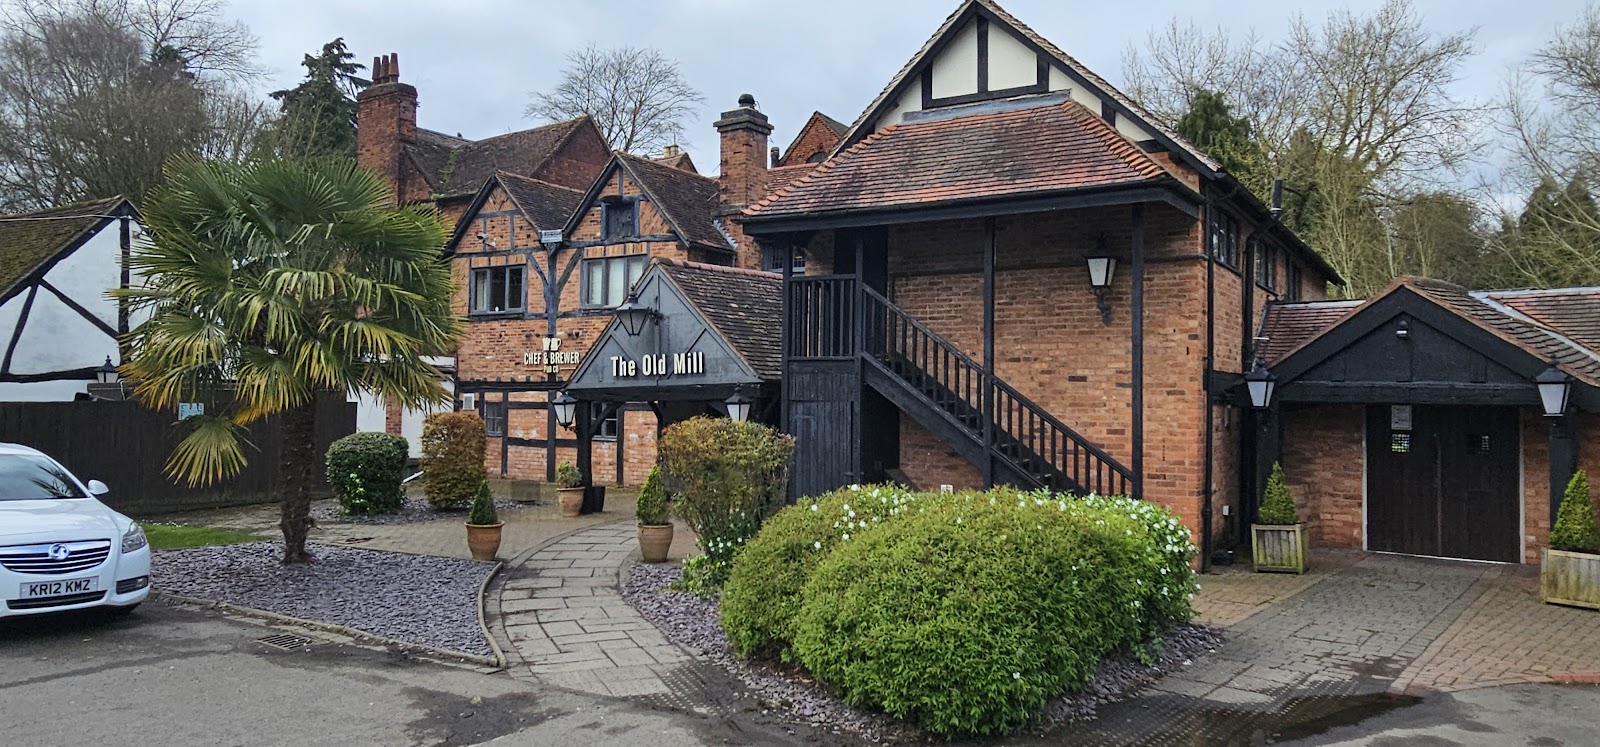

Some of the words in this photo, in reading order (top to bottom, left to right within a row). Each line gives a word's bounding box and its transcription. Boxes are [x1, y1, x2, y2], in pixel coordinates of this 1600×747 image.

[524, 352, 542, 365] CHEF
[543, 352, 549, 365] &
[550, 351, 580, 364] BREWER
[610, 355, 636, 377] The
[642, 353, 666, 376] Old
[673, 351, 703, 375] Mill
[29, 583, 62, 596] KR12
[65, 580, 90, 592] KMZ
